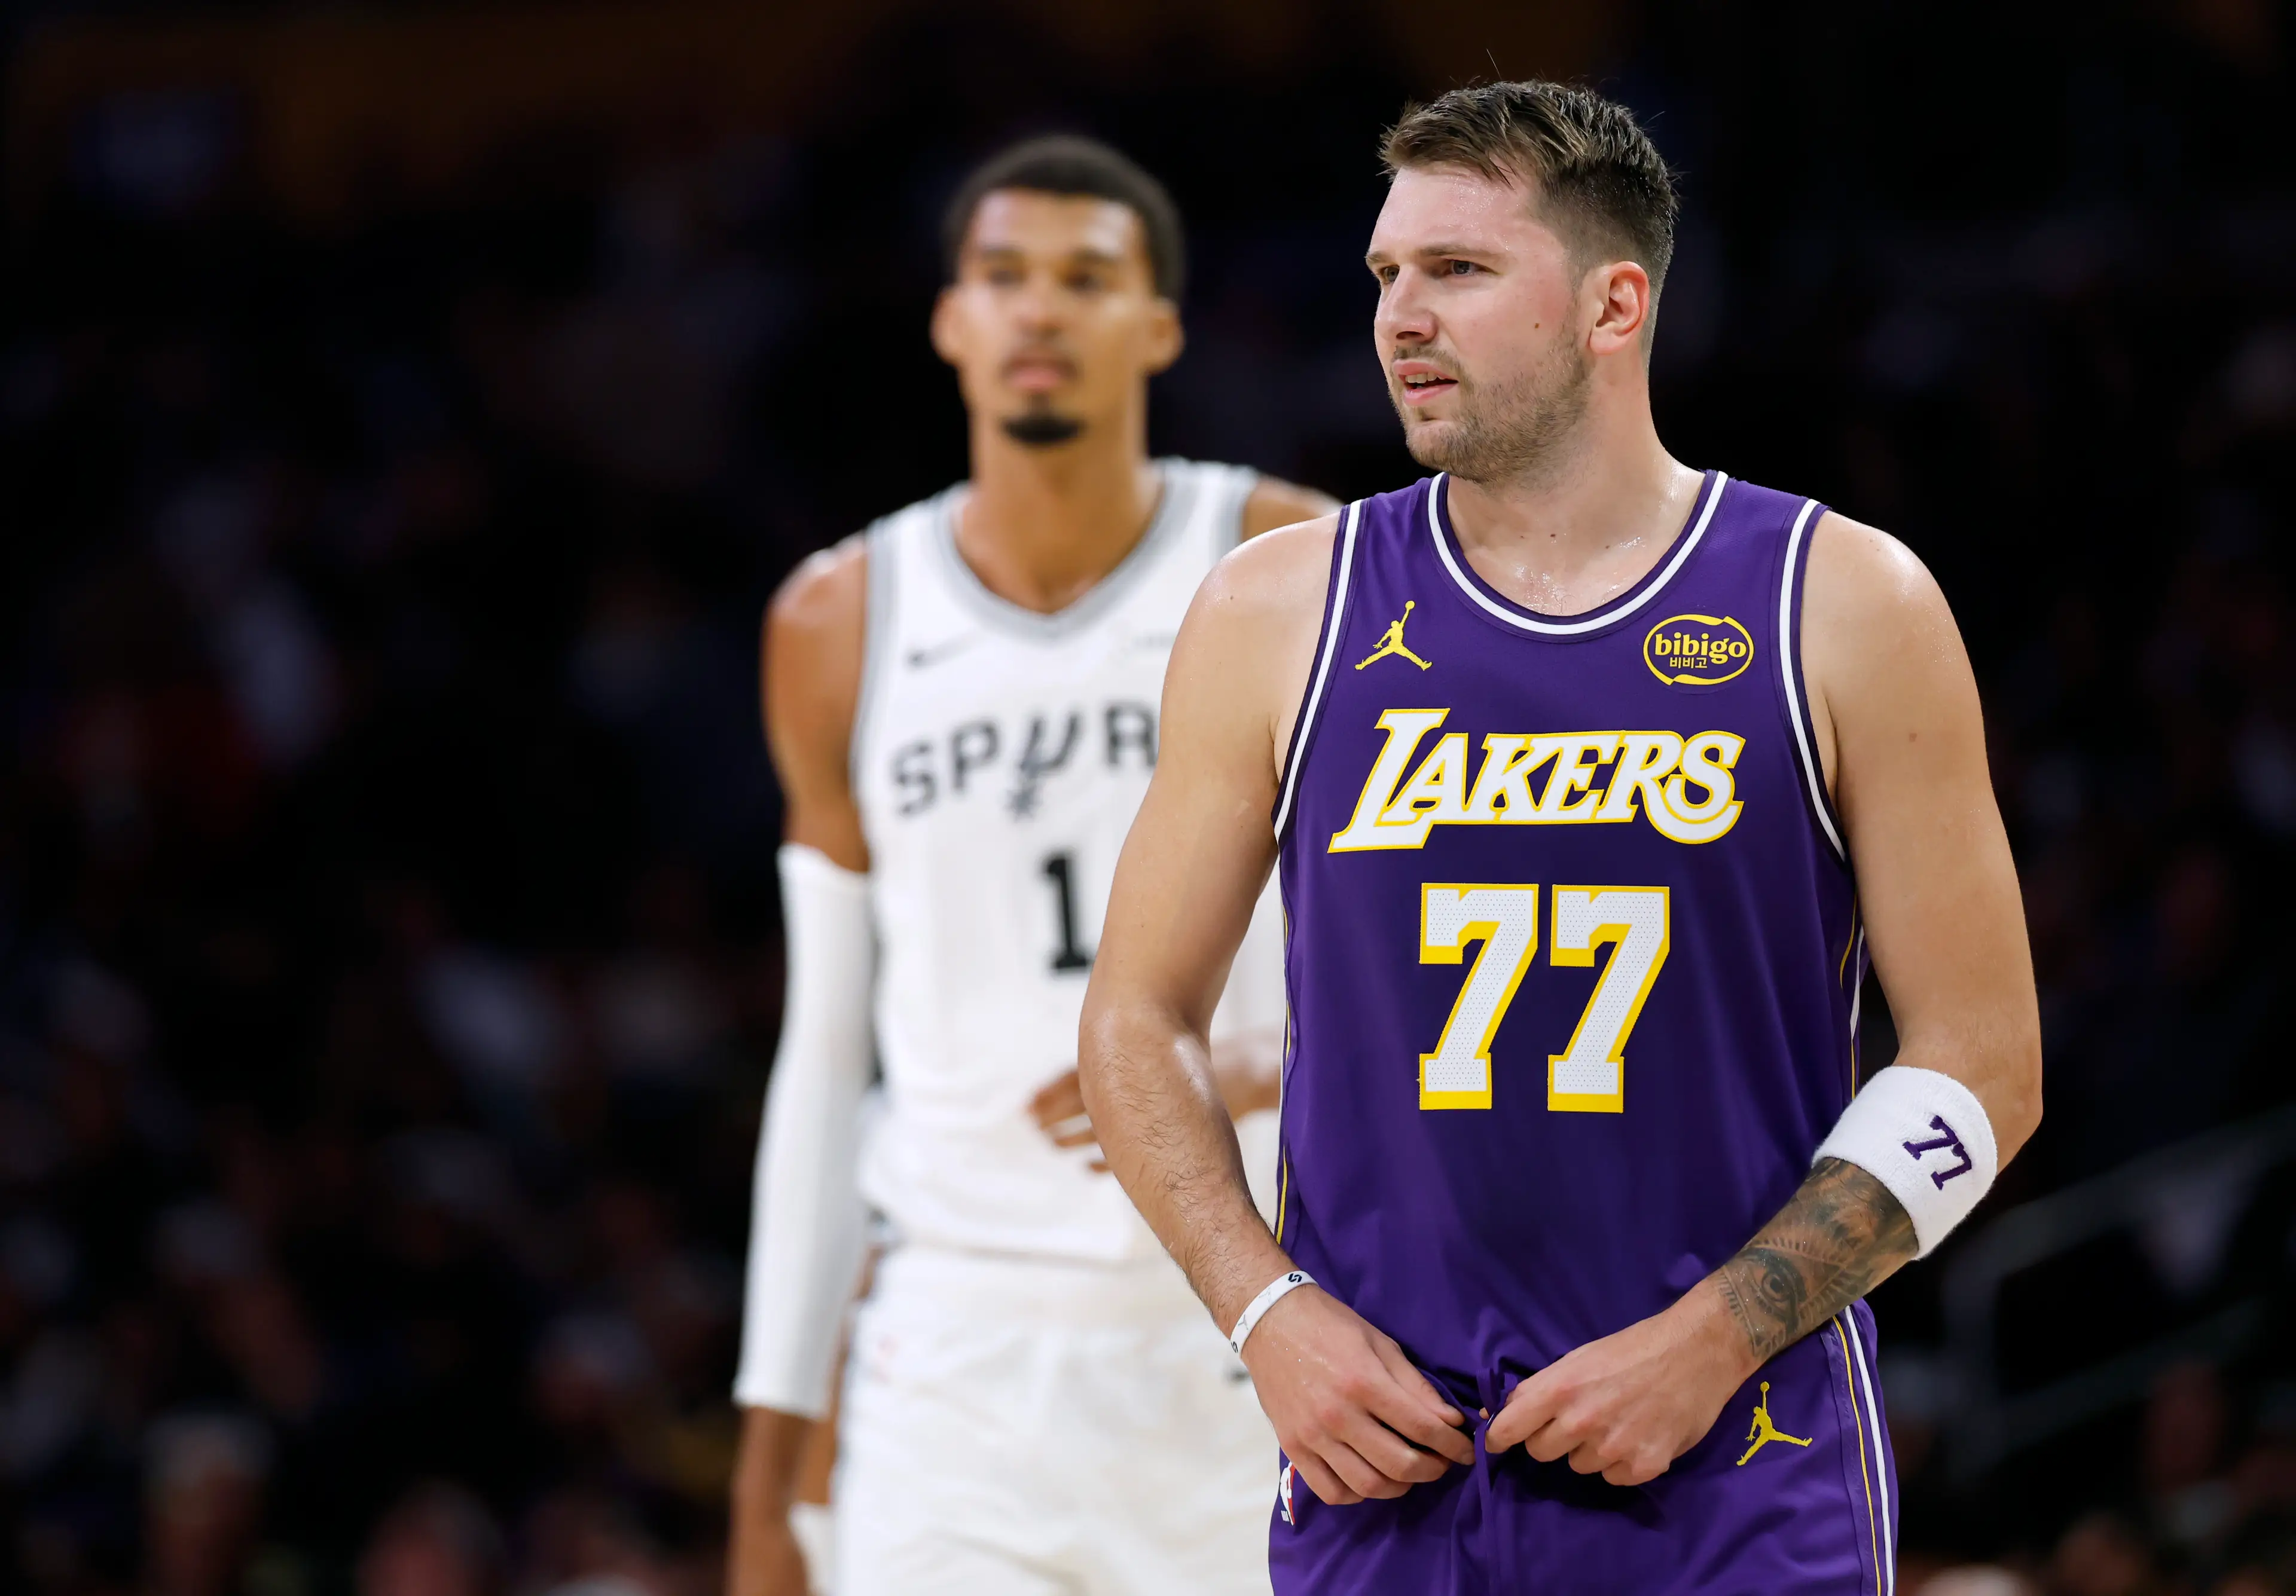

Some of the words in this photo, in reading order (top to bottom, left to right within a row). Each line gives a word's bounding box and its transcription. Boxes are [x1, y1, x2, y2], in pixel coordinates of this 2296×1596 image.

[1654, 632, 1747, 664] bibigo
[1669, 657, 1708, 669] 비비고
[1327, 708, 1747, 854] LAKERS
[1043, 851, 1097, 972] 1
[1419, 882, 1670, 1113] 77
[1903, 1115, 1973, 1190] 77
